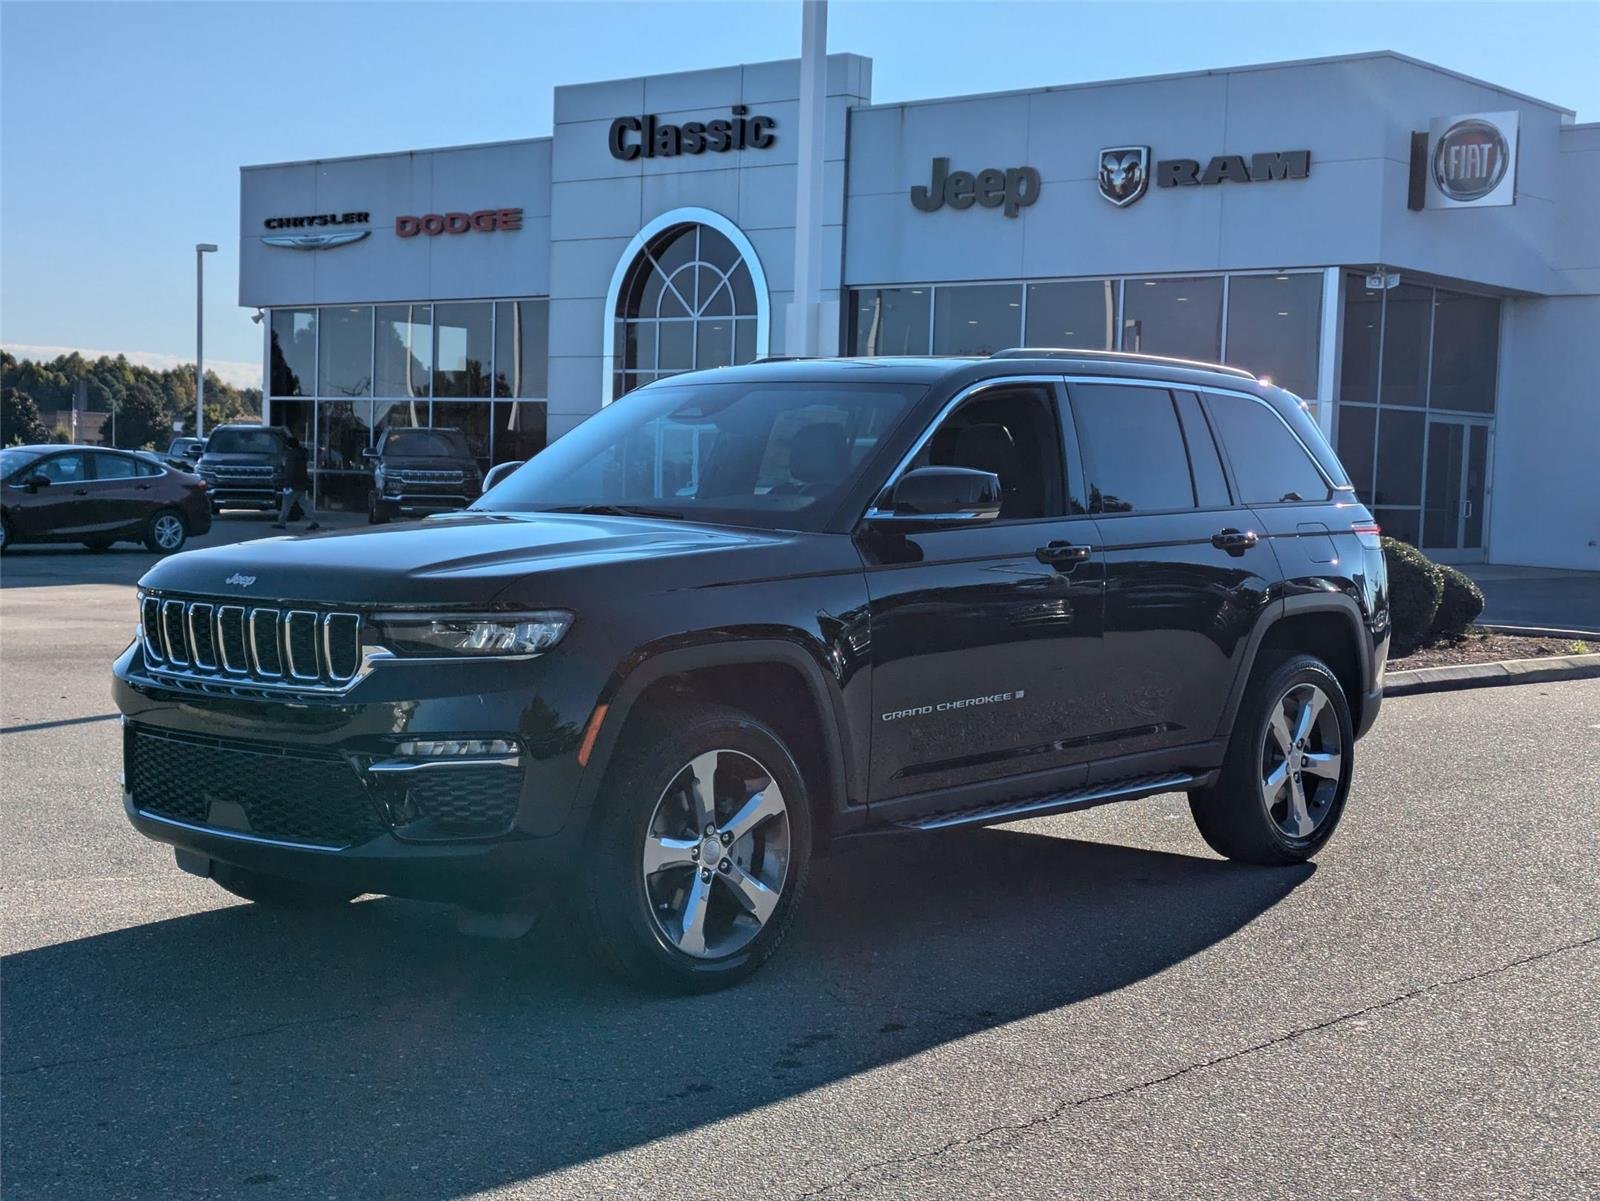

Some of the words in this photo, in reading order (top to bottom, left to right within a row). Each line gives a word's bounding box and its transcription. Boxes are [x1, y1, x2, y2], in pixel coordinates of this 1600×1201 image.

[608, 105, 777, 161] Classic
[1157, 150, 1310, 187] RAM
[1449, 143, 1493, 180] FIAT
[911, 157, 1041, 218] Jeep
[264, 211, 370, 229] CHRYSLER
[395, 208, 523, 237] DODGE
[225, 572, 257, 588] Jeep
[882, 705, 932, 721] GRAND
[937, 692, 1011, 711] CHEROKEE
